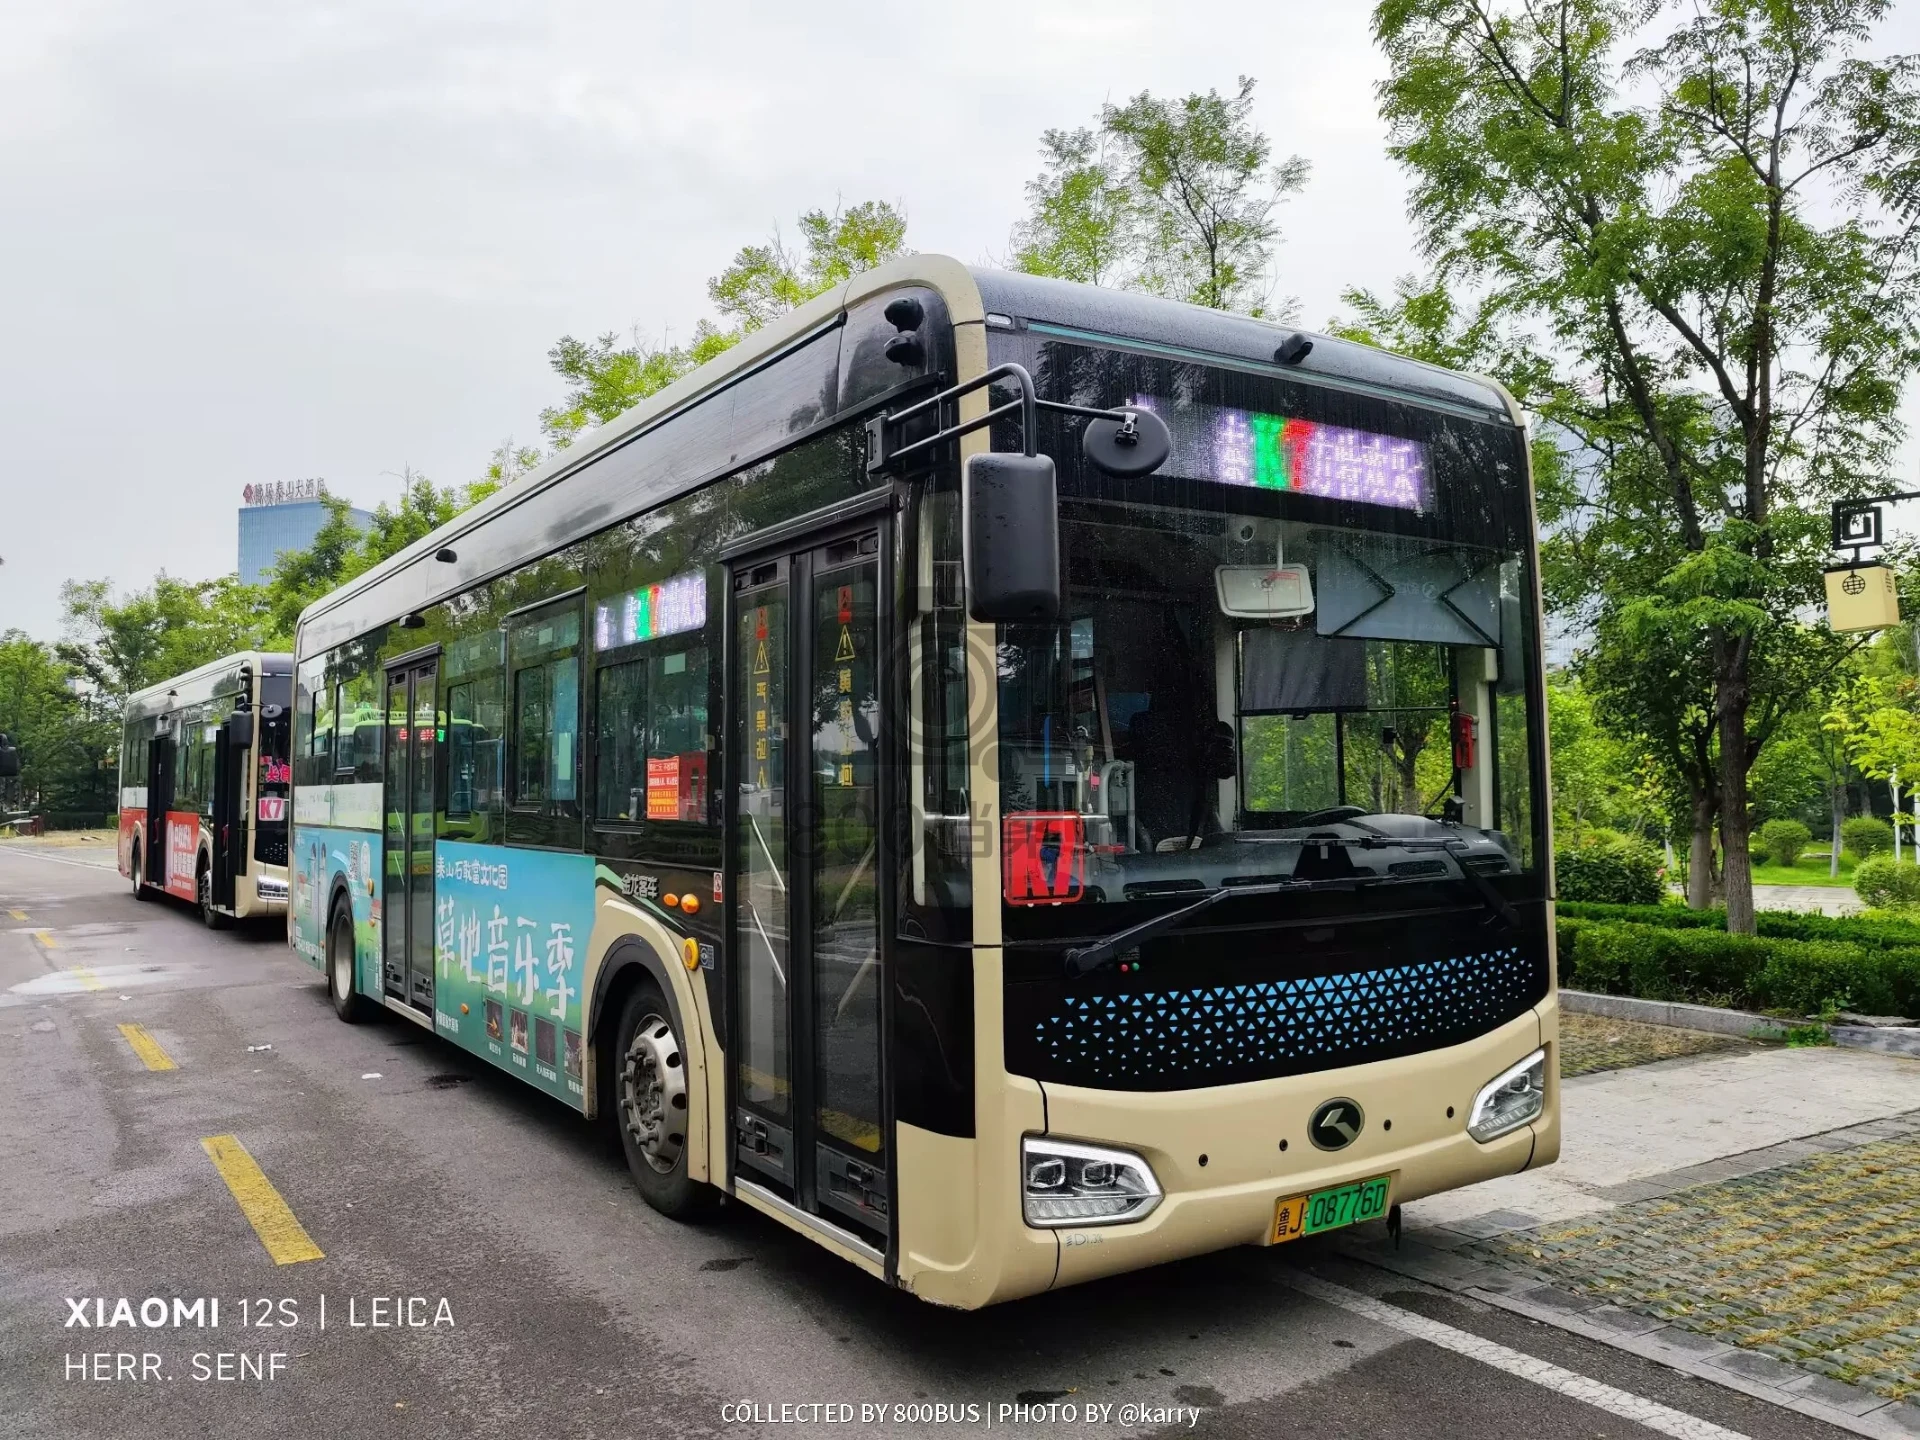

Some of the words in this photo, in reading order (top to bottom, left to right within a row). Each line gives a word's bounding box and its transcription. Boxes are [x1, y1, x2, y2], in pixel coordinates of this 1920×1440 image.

[260, 799, 282, 819] K7
[1010, 819, 1077, 897] K7
[437, 895, 575, 1021] 草地音乐季
